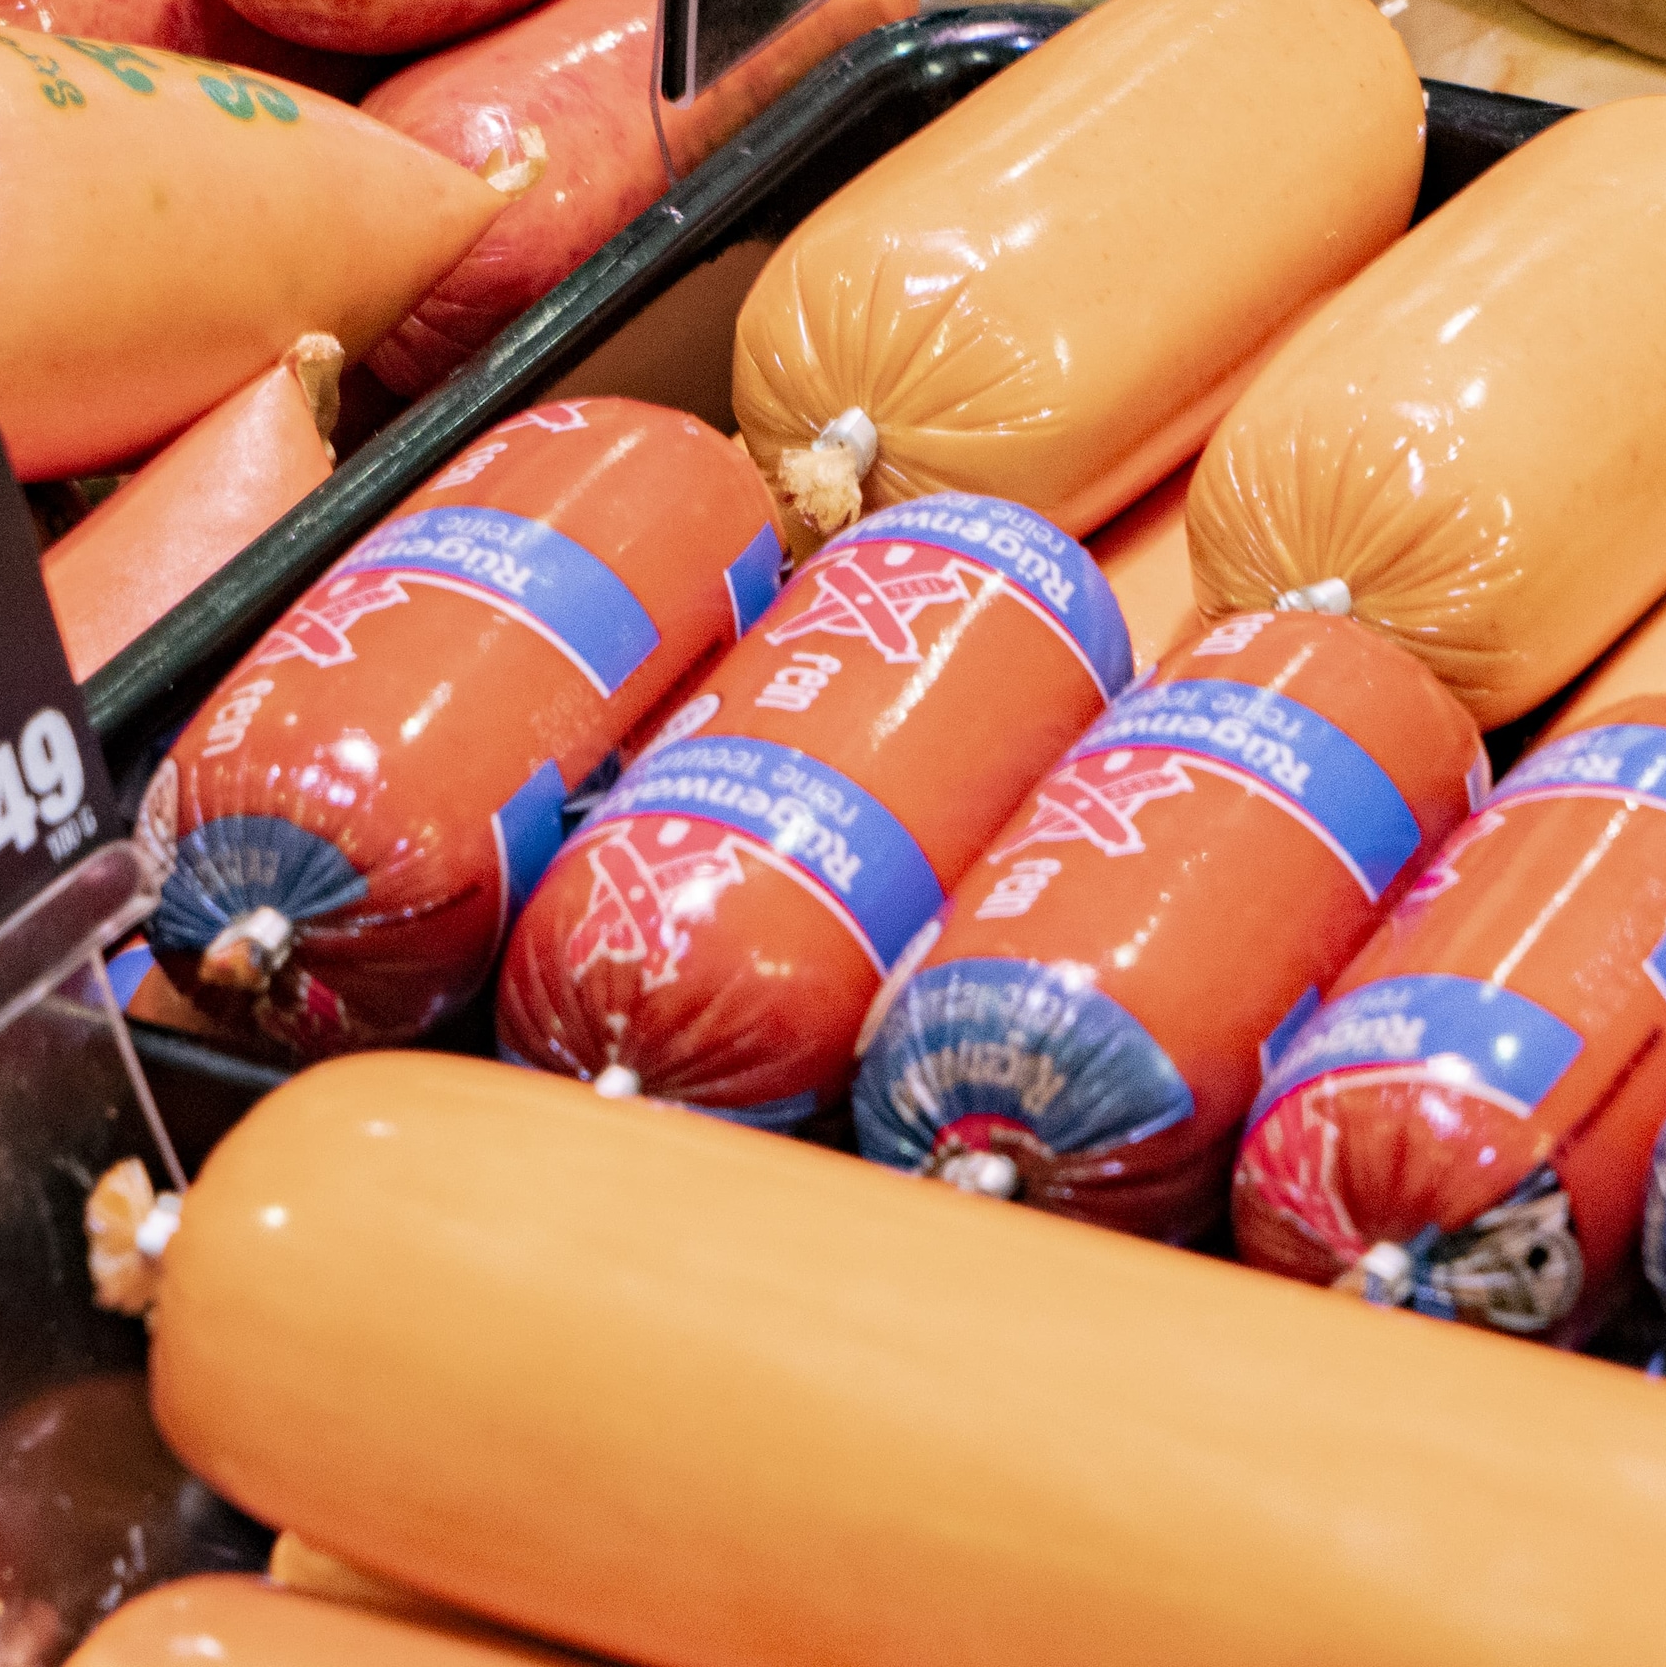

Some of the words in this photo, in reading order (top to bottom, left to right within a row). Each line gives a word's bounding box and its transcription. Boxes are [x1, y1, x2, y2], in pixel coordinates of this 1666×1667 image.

[754, 651, 842, 712] fein
[201, 678, 275, 758] fein
[975, 858, 1063, 920] fein
